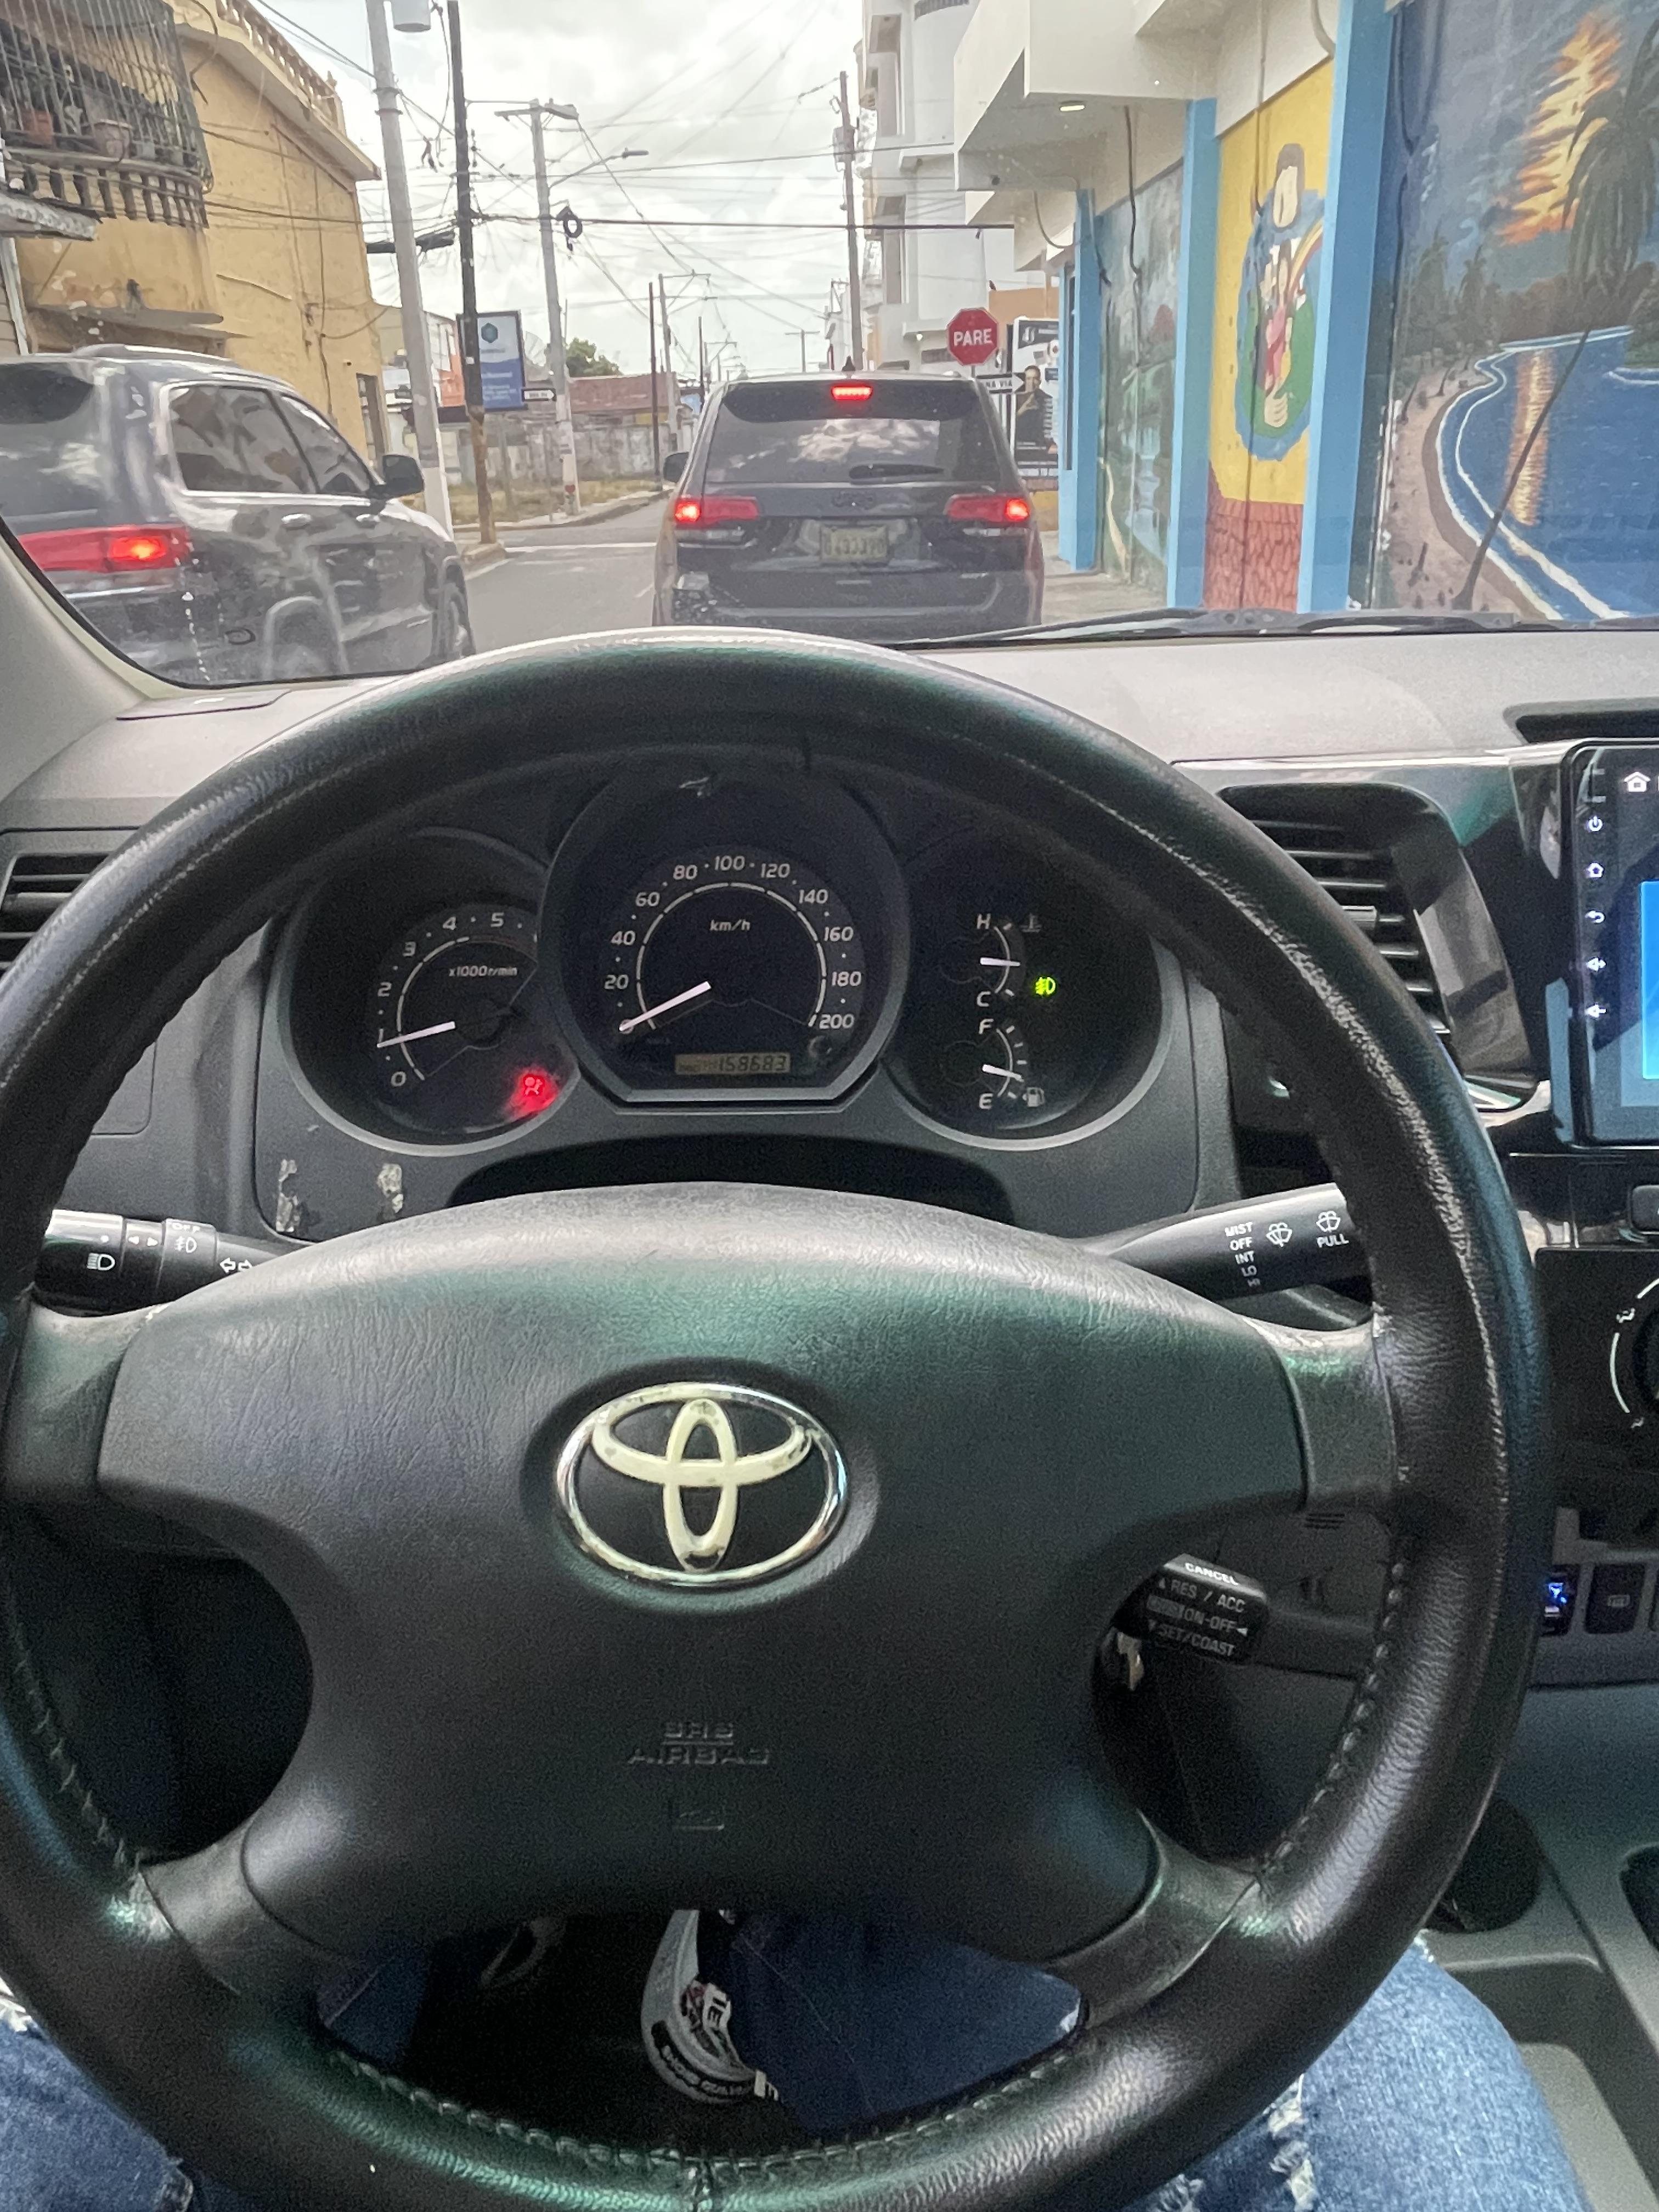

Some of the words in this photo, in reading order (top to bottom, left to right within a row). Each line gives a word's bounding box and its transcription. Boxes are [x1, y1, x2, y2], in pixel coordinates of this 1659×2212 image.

[953, 328, 992, 346] PARE
[714, 856, 745, 871] 100
[760, 863, 790, 878] 120
[673, 865, 697, 880] 80
[635, 892, 660, 907] 60
[799, 889, 828, 904] 140
[442, 917, 456, 930] 4
[490, 912, 504, 927] 5
[710, 919, 751, 931] km/h
[977, 913, 991, 929] H
[611, 930, 635, 945] 40
[824, 927, 854, 941] 160
[403, 941, 416, 956] 3
[605, 974, 629, 990] 20
[831, 971, 862, 987] 180
[377, 982, 392, 997] 2
[977, 991, 991, 1007] C
[819, 1014, 855, 1029] 200
[979, 1019, 994, 1034] F
[719, 1054, 787, 1071] 158683
[391, 1071, 407, 1086] 0
[979, 1093, 993, 1109] E
[1224, 1221, 1253, 1237] MIST
[1230, 1237, 1252, 1250] OFF
[1317, 1234, 1350, 1248] PULL
[1235, 1251, 1254, 1264] INT
[1241, 1265, 1257, 1277] LO
[1185, 1562, 1239, 1585] CANCEL
[1171, 1579, 1197, 1599] RES
[1217, 1594, 1246, 1613] ACC
[628, 1747, 768, 1764] AIRBAG
